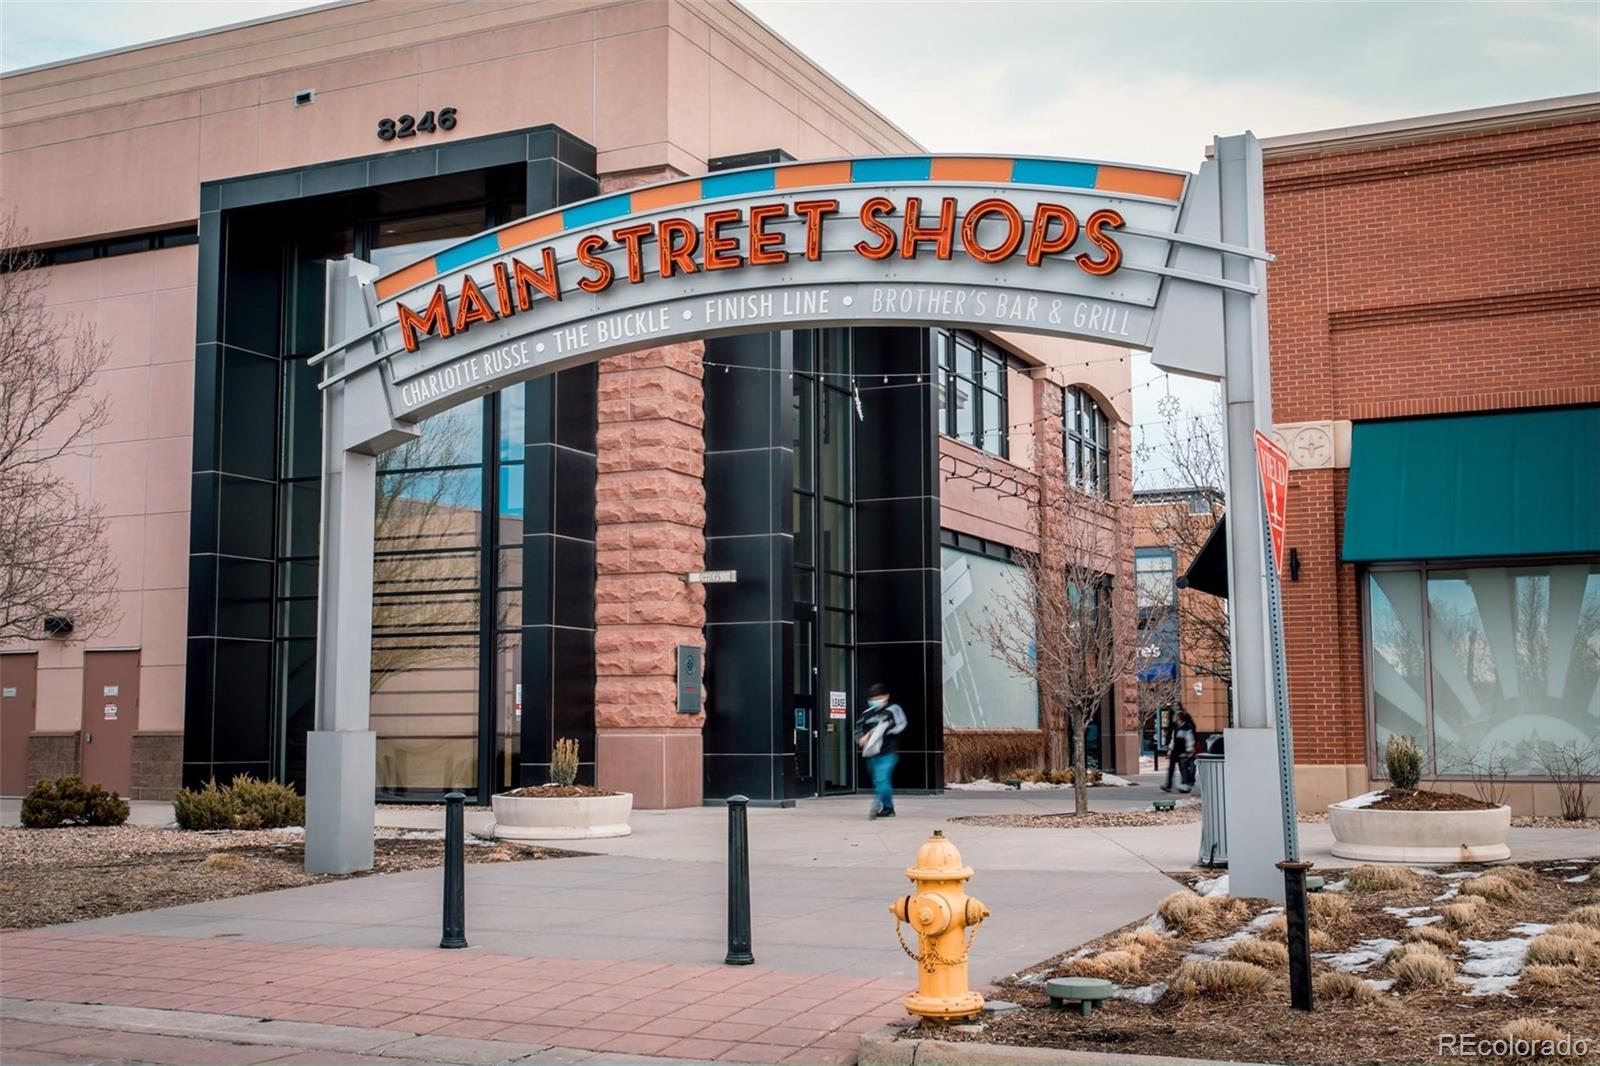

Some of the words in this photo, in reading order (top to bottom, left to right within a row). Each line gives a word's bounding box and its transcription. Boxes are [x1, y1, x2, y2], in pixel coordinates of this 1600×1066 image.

[377, 107, 458, 141] 8246
[396, 247, 563, 353] MAIN
[576, 199, 839, 293] STREET
[854, 197, 1127, 277] SHOPS
[705, 293, 773, 323] FINISH
[783, 290, 830, 316] LINE
[872, 288, 987, 316] BROTHER'S
[995, 293, 1040, 322] BAR
[1048, 300, 1063, 324] &
[1073, 302, 1130, 336] GRILL
[552, 324, 590, 353] THE
[597, 307, 670, 343] BUCKLE
[402, 358, 479, 407] CHARLOTTE
[482, 341, 530, 376] RUSSE
[1260, 447, 1286, 487] YIELD
[831, 698, 846, 707] LEASE
